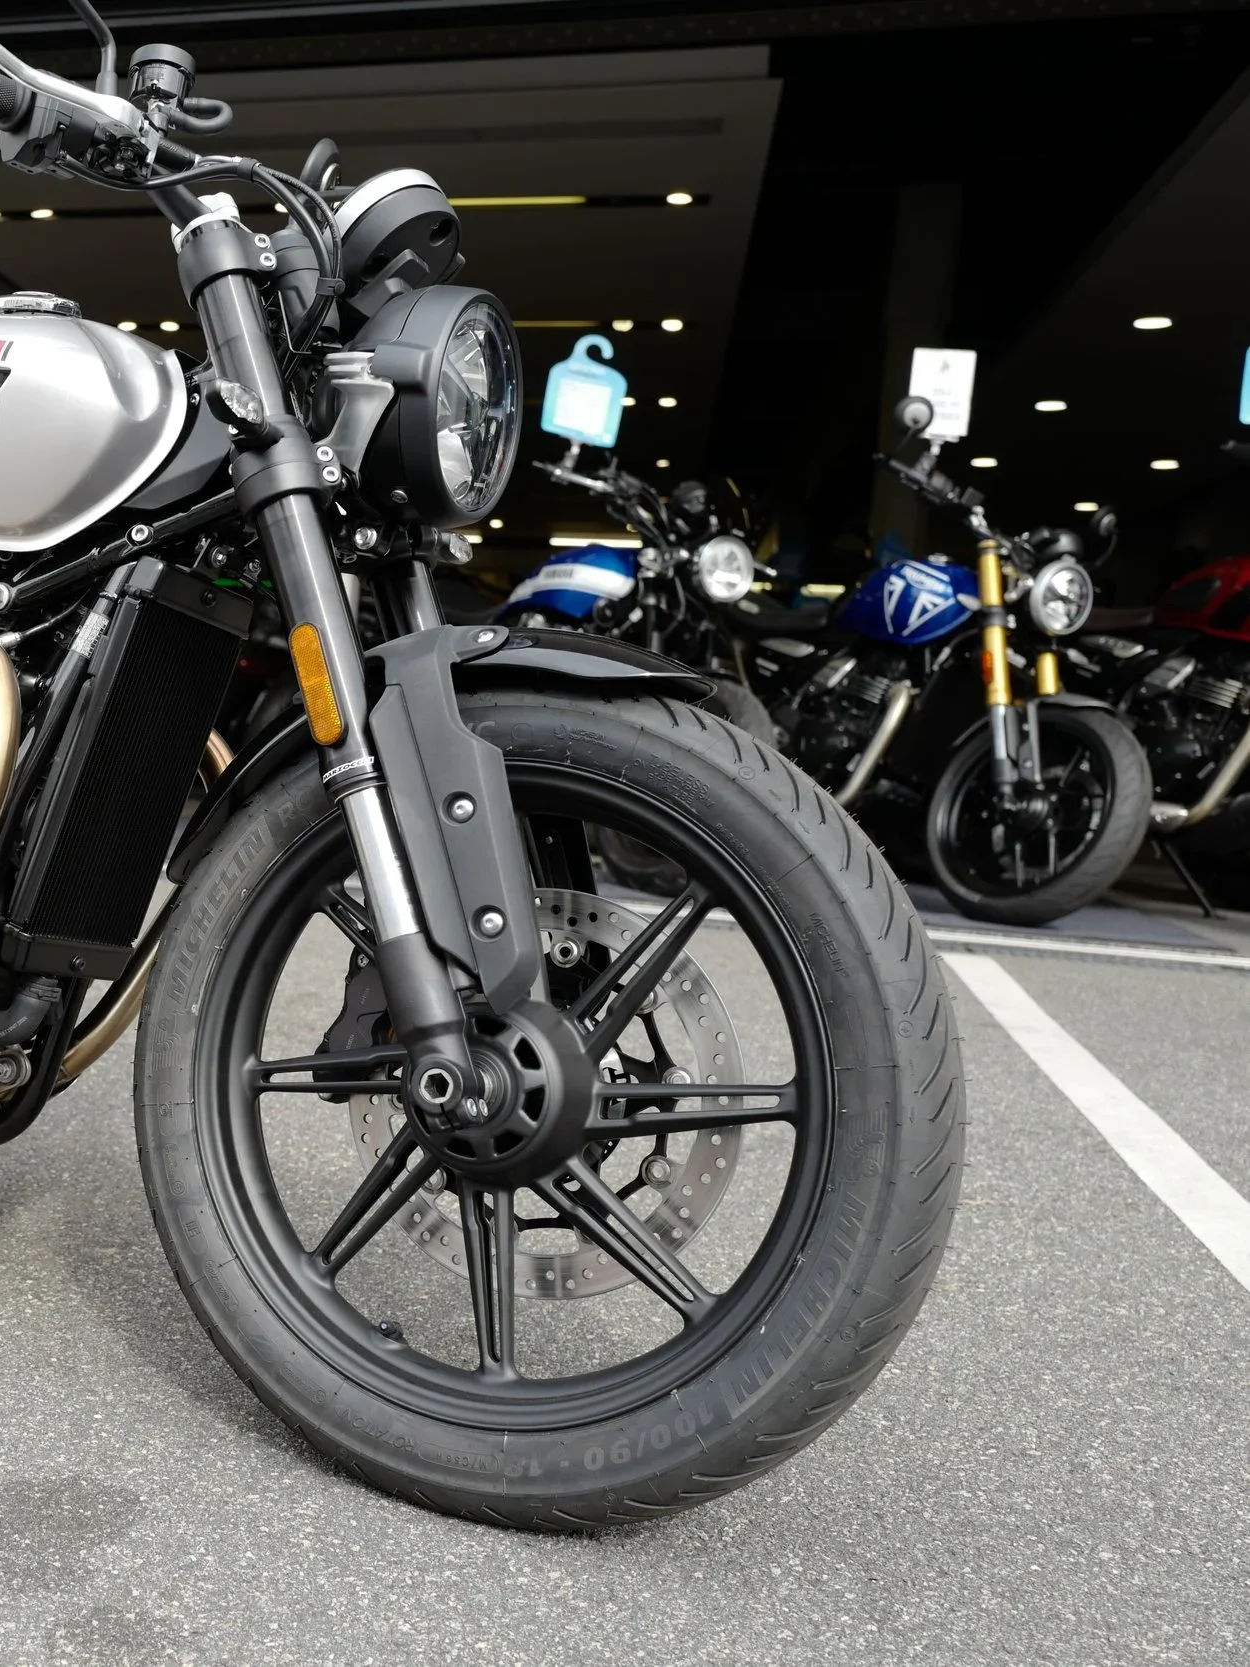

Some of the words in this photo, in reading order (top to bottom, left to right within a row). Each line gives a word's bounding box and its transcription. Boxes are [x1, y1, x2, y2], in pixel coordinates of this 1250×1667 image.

[168, 826, 272, 1005] MICHELIN
[808, 912, 845, 973] MICHELIN
[730, 1190, 869, 1407] MICHELIN
[583, 1409, 716, 1472] 100/90
